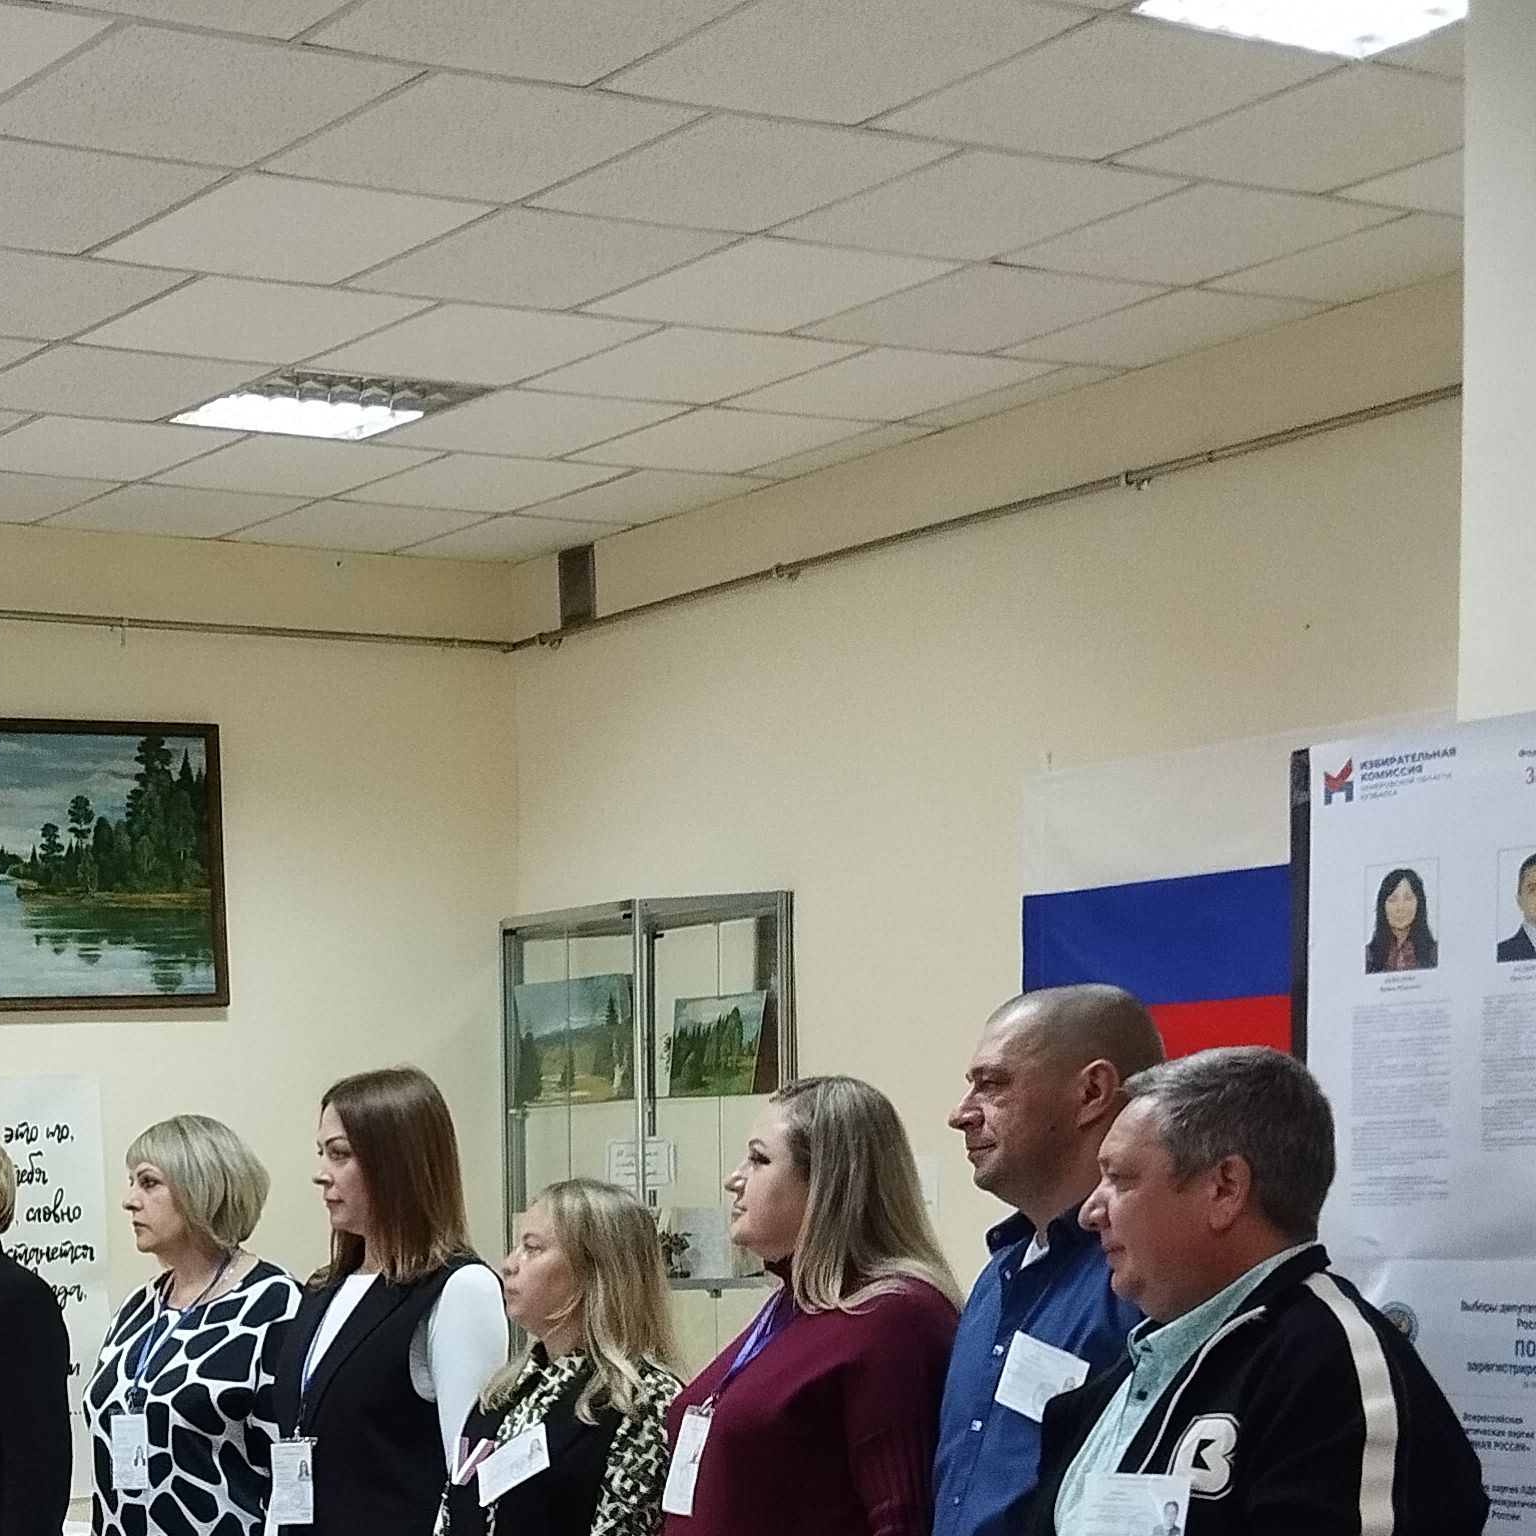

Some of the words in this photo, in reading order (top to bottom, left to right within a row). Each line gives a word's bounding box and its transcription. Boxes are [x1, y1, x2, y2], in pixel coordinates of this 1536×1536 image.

[1360, 747, 1457, 770] ИЗБИРАТЕЛЬНАЯ
[1360, 764, 1424, 782] КОМИССИЯ
[4, 1121, 39, 1143] это
[26, 1188, 82, 1223] словно
[6, 1240, 95, 1265] станется
